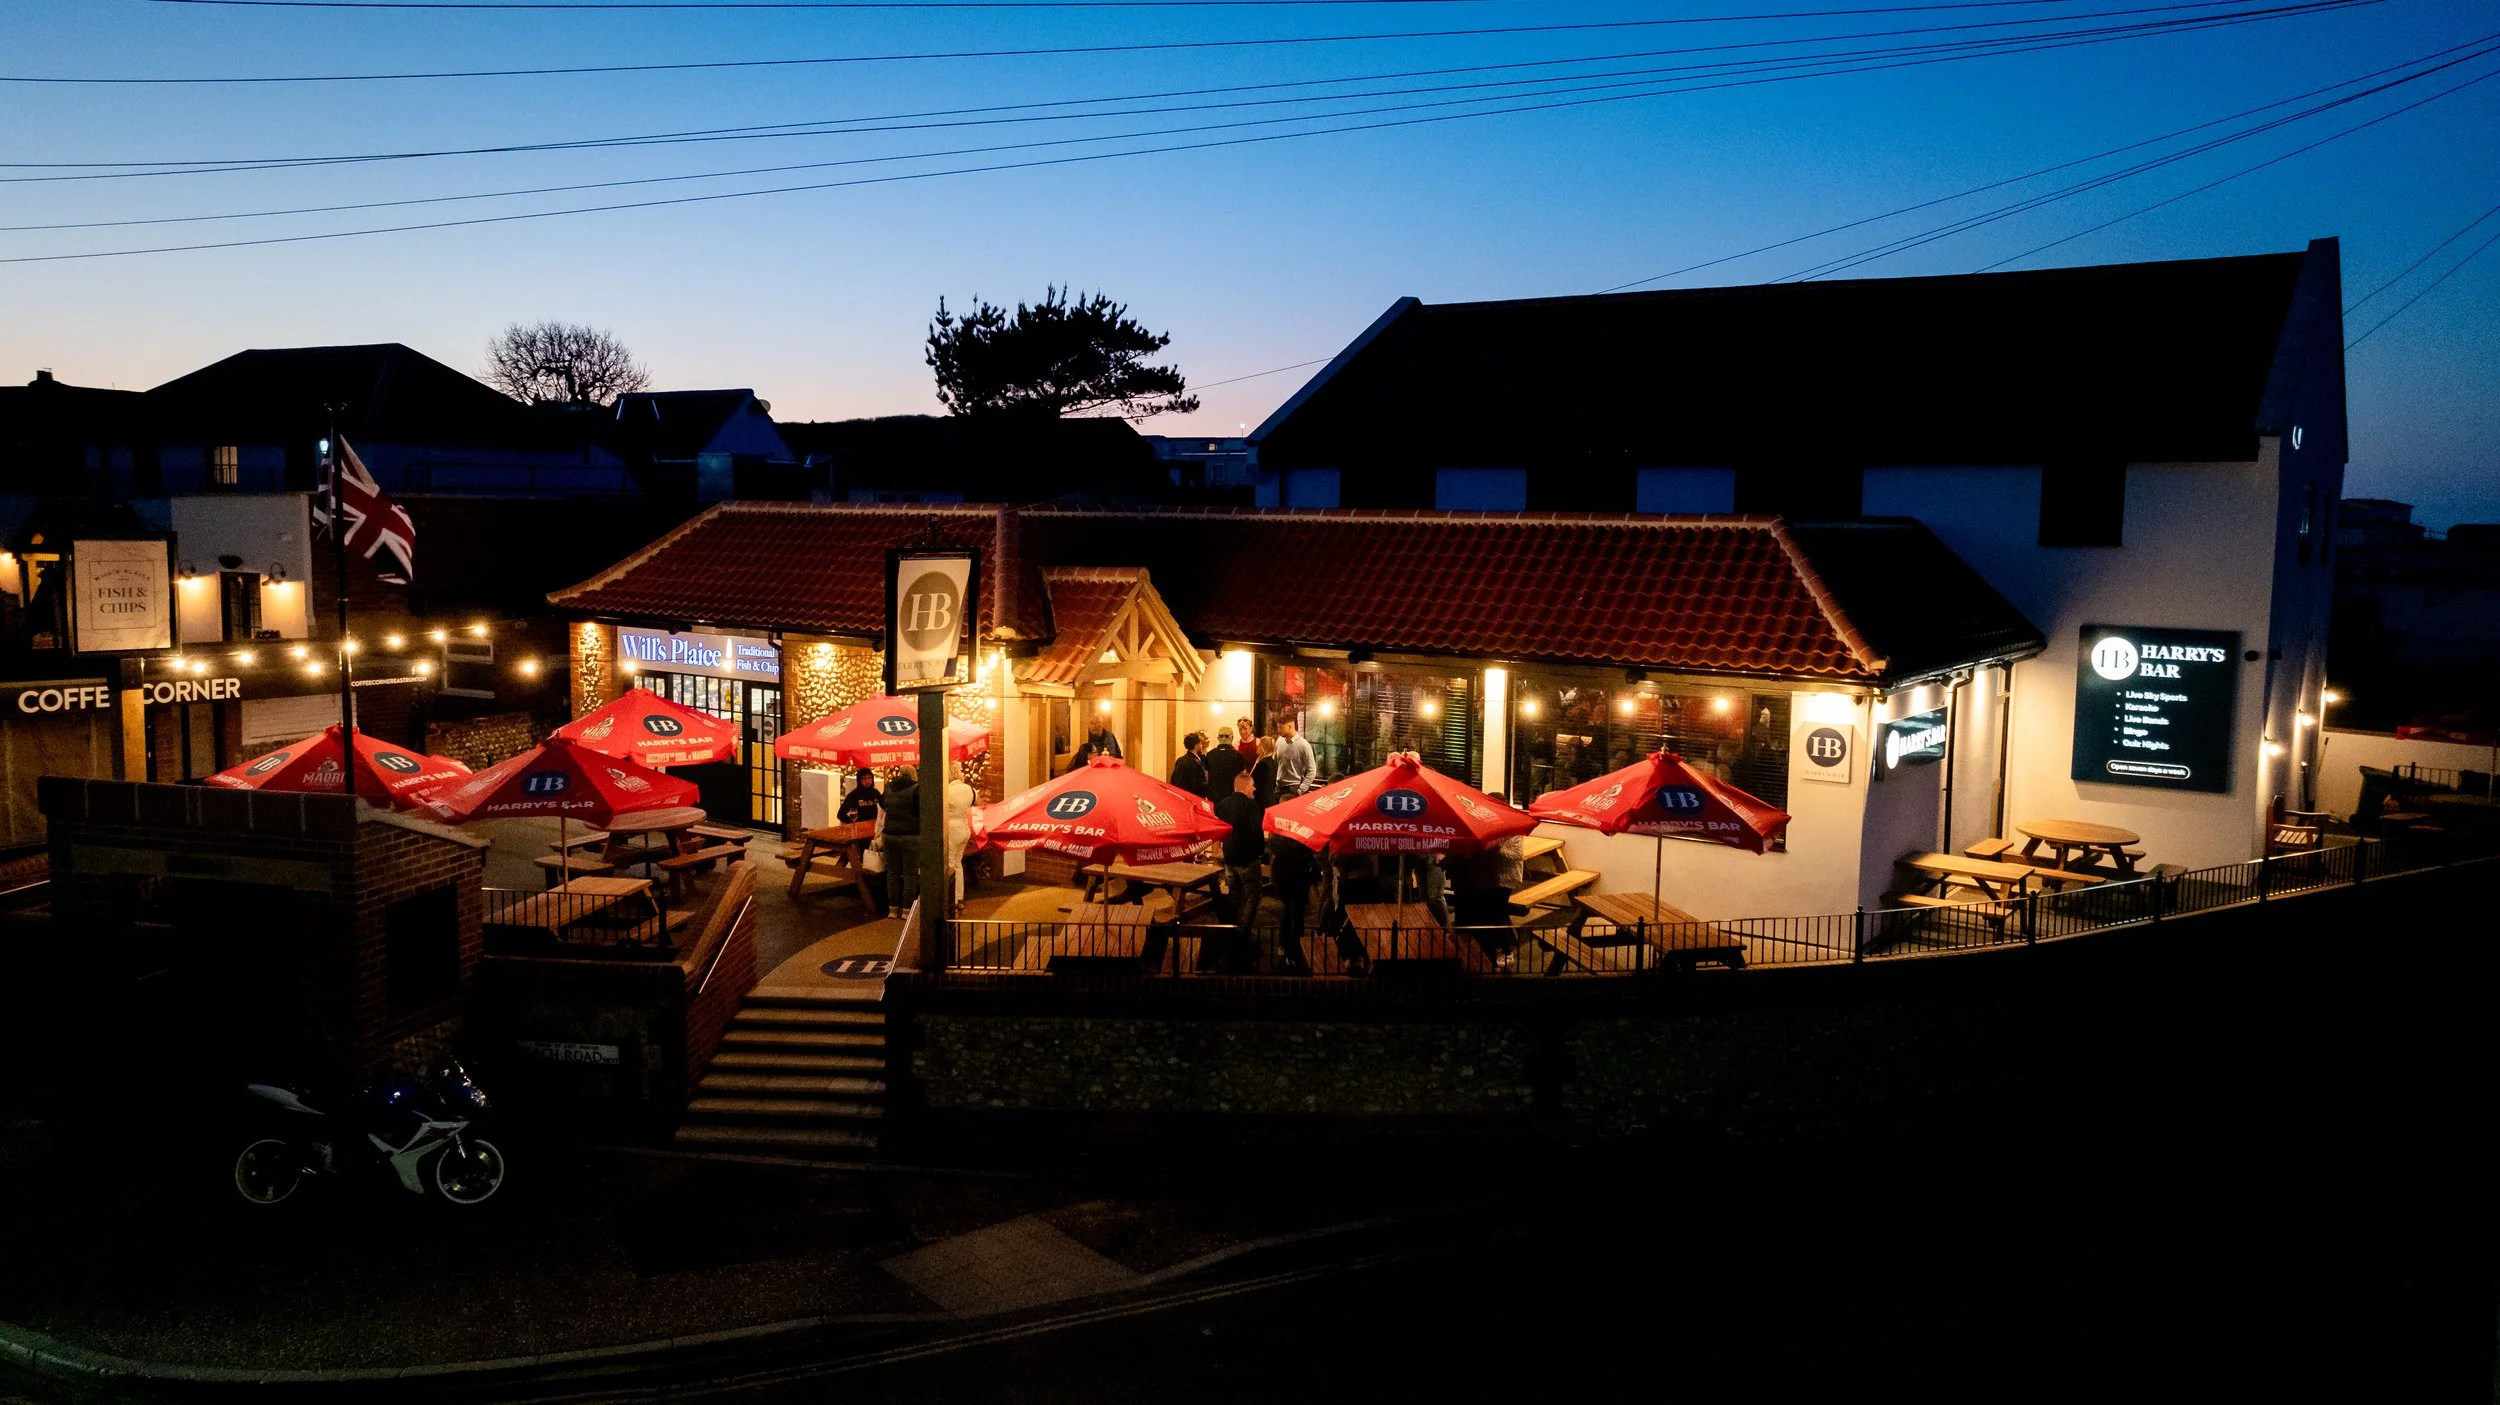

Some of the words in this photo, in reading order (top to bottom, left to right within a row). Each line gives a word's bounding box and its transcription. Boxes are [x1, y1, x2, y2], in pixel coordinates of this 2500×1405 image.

[98, 587, 132, 598] FISH
[136, 587, 147, 597] &
[100, 602, 147, 614] CHIPS
[906, 592, 952, 631] HB
[622, 634, 668, 661] Will's
[670, 637, 722, 668] Plaice
[736, 644, 775, 658] Traditional
[2140, 644, 2226, 662] HARRY'S
[736, 658, 752, 671] Fish
[752, 660, 760, 672] &
[761, 660, 779, 676] Chip
[2140, 663, 2181, 678] BAR
[18, 686, 110, 713] COFFE
[143, 678, 241, 705] CORNER
[648, 719, 678, 732] HB
[882, 719, 913, 732] HB
[637, 738, 687, 748] HARRY'S
[688, 736, 714, 745] BAR
[862, 738, 917, 747] HARRY'S
[1811, 736, 1842, 758] HB
[253, 757, 281, 771] HB
[380, 756, 414, 770] HB
[391, 774, 435, 790] HARRY'S
[433, 771, 459, 780] BAR
[528, 777, 564, 792] HB
[487, 801, 557, 813] HARRY'S
[1052, 797, 1090, 813] HB
[1384, 795, 1422, 812] HB
[1663, 792, 1700, 809] HB
[1008, 823, 1072, 834] HARRY'S
[1074, 826, 1106, 837] BAR
[1349, 823, 1419, 832] HARRY'S
[1422, 825, 1456, 835] BAR
[1708, 821, 1741, 832] BAR
[1044, 839, 1062, 852] SOUL
[1355, 837, 1390, 850] DISCOVER
[1397, 838, 1416, 850] SOUL
[564, 1049, 602, 1063] ROAD
